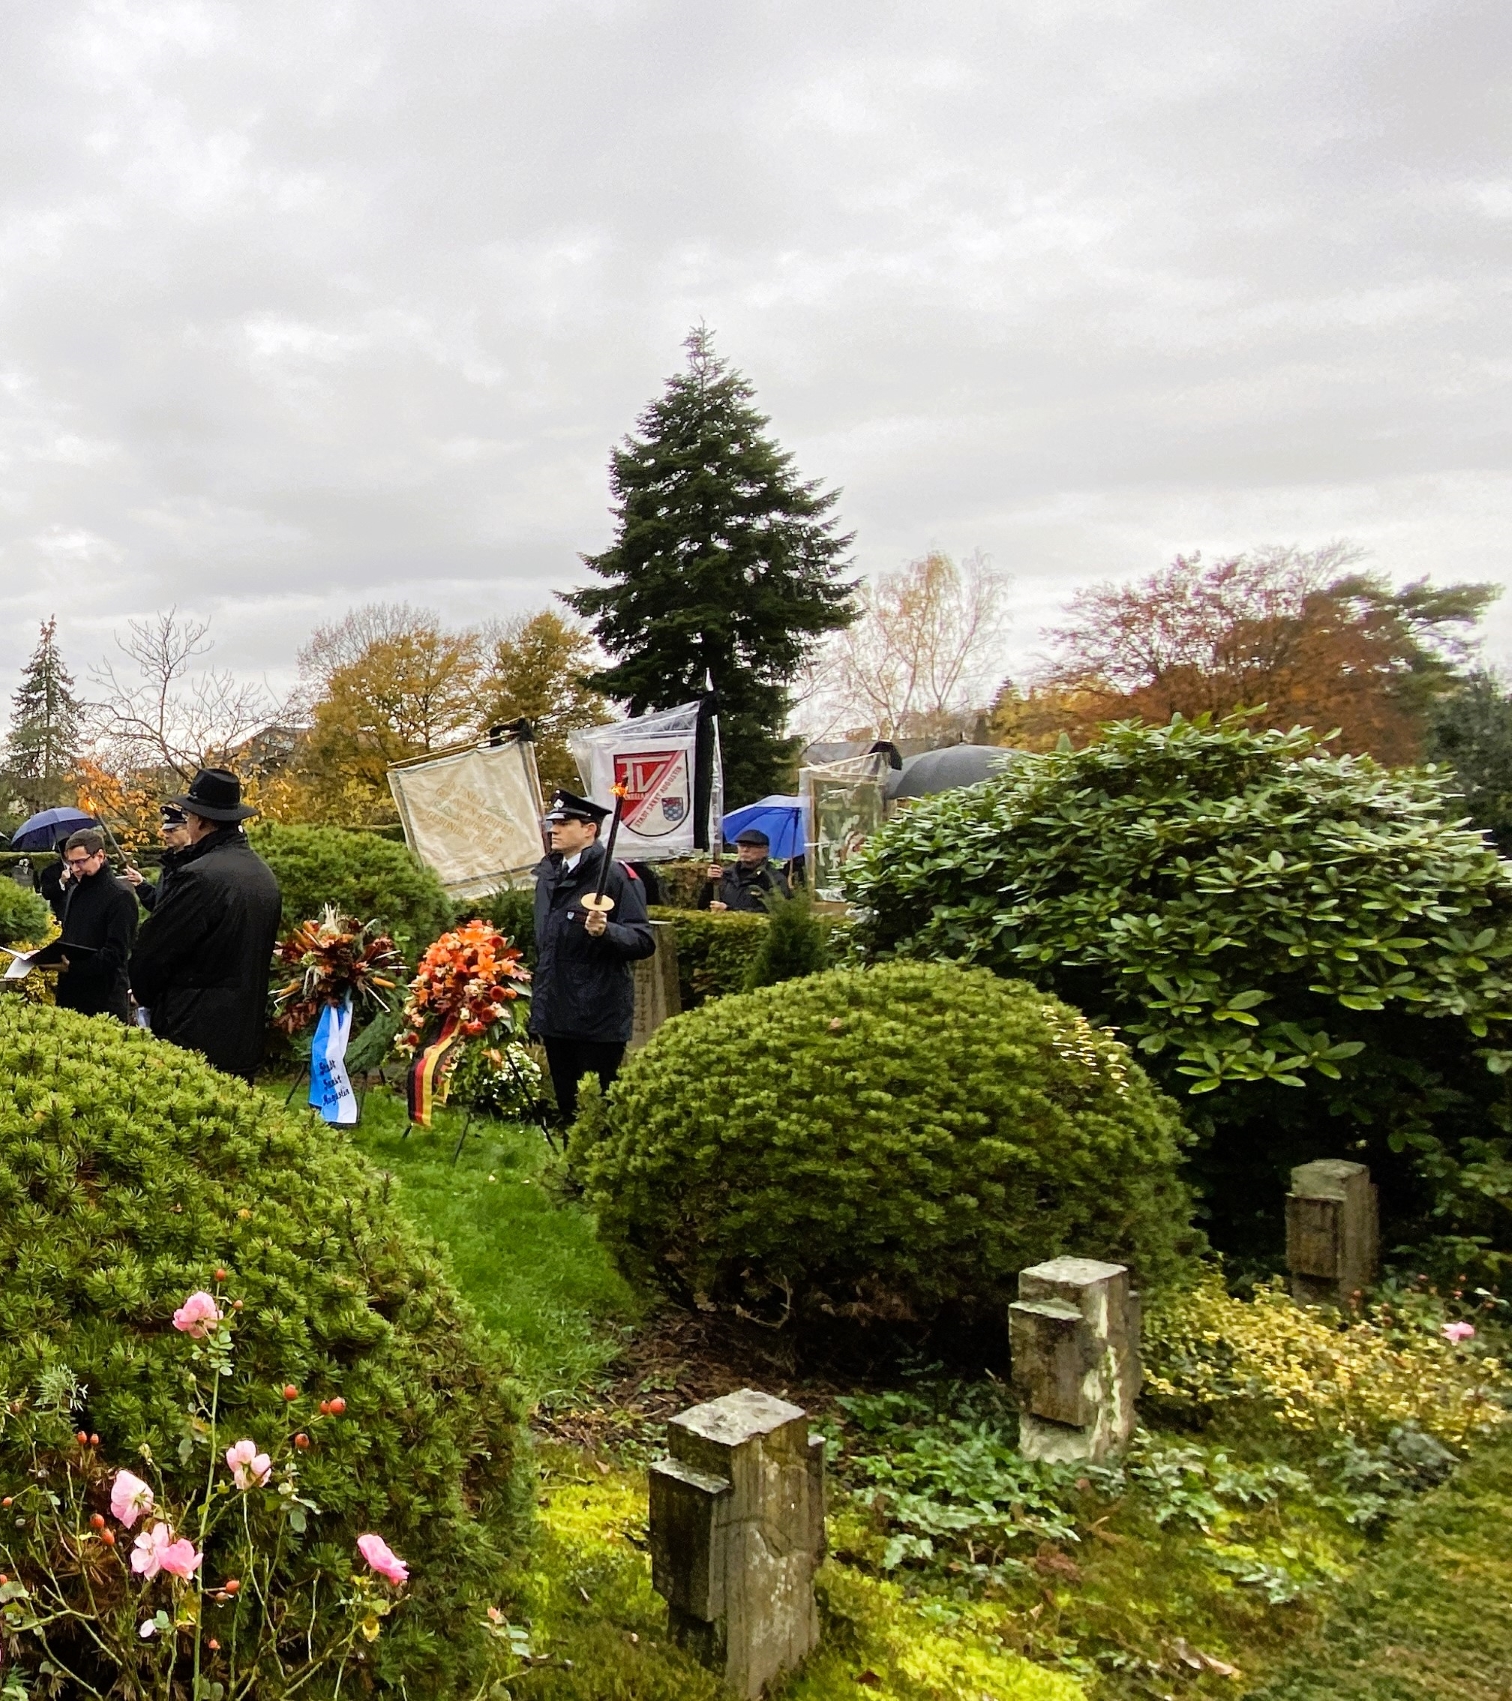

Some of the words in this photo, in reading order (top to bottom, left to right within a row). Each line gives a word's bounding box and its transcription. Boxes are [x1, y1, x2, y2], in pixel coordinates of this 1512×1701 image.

[617, 755, 672, 793] TV
[635, 811, 649, 827] STADT
[647, 794, 662, 812] SANKT
[660, 766, 683, 793] AUGUSTIN
[319, 1060, 336, 1075] Stadt
[323, 1075, 342, 1090] Sankt
[323, 1088, 350, 1106] Augustin
